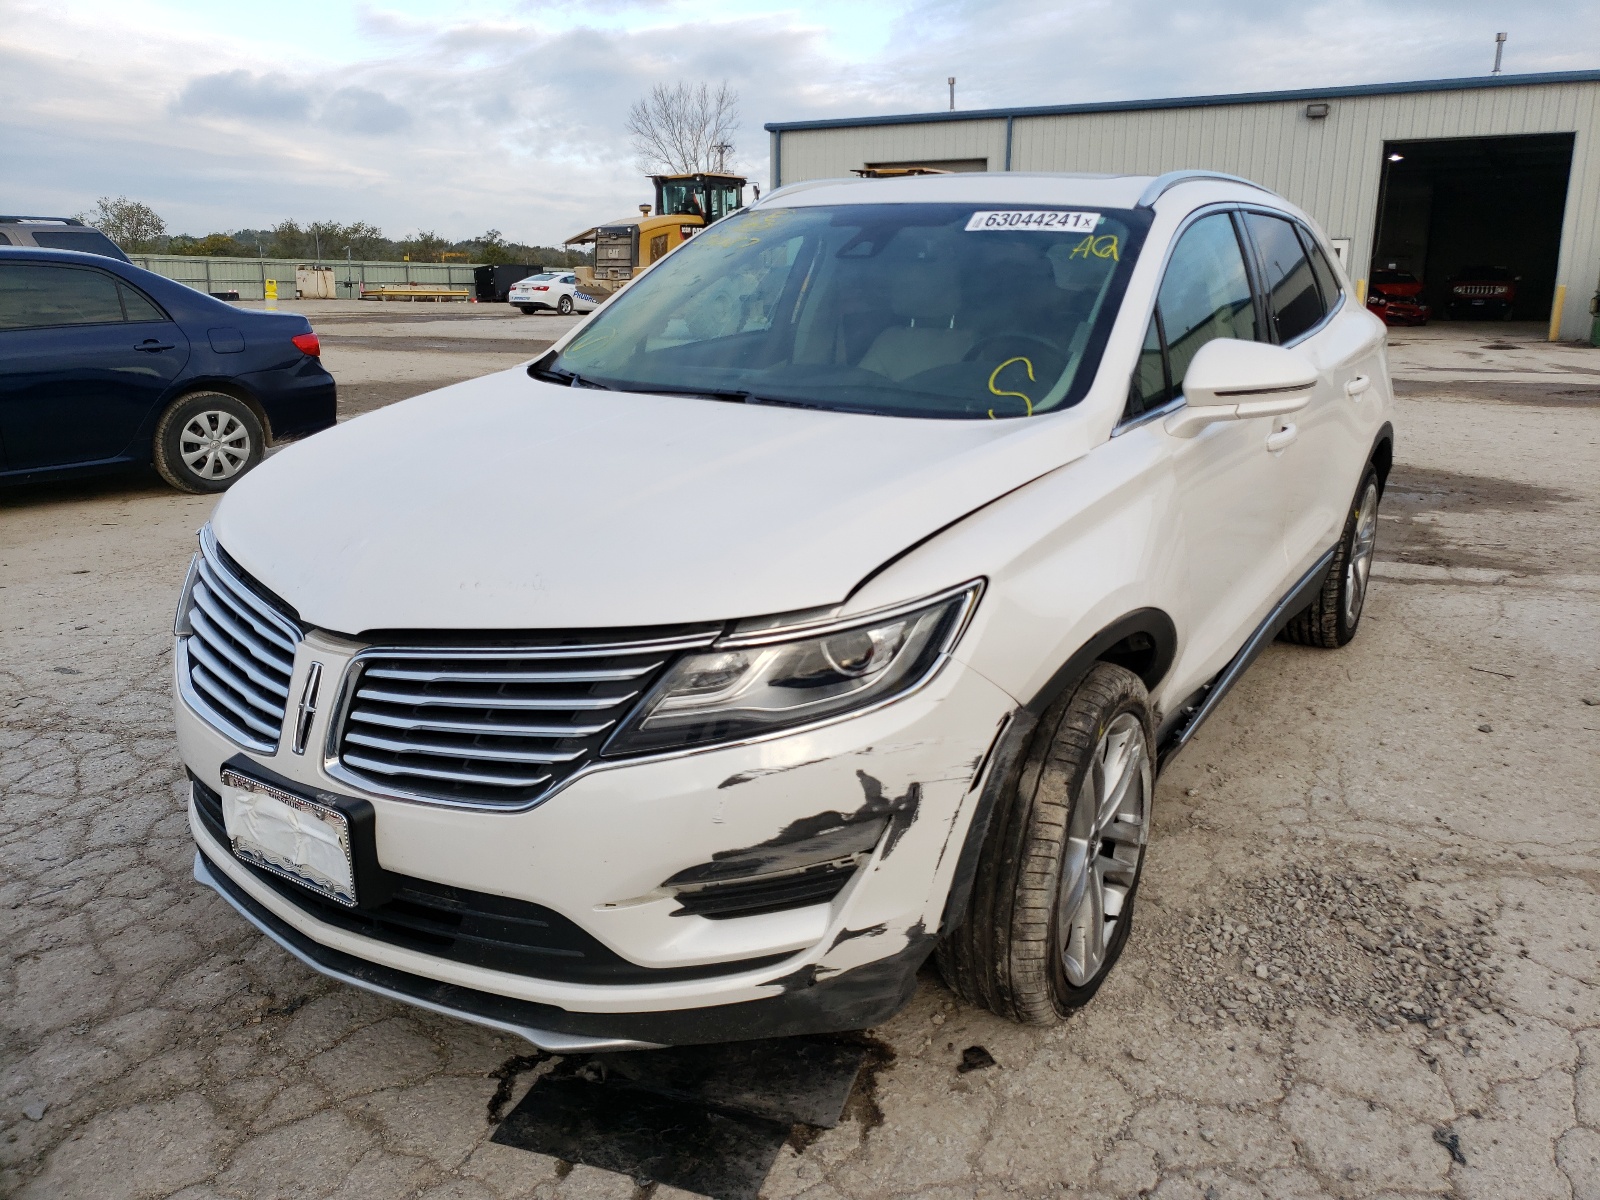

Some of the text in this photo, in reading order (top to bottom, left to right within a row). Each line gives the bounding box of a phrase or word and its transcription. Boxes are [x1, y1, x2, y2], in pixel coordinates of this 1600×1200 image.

[608, 249, 620, 258] CAT
[988, 356, 1036, 420] S
[268, 792, 302, 811] MISSOURI
